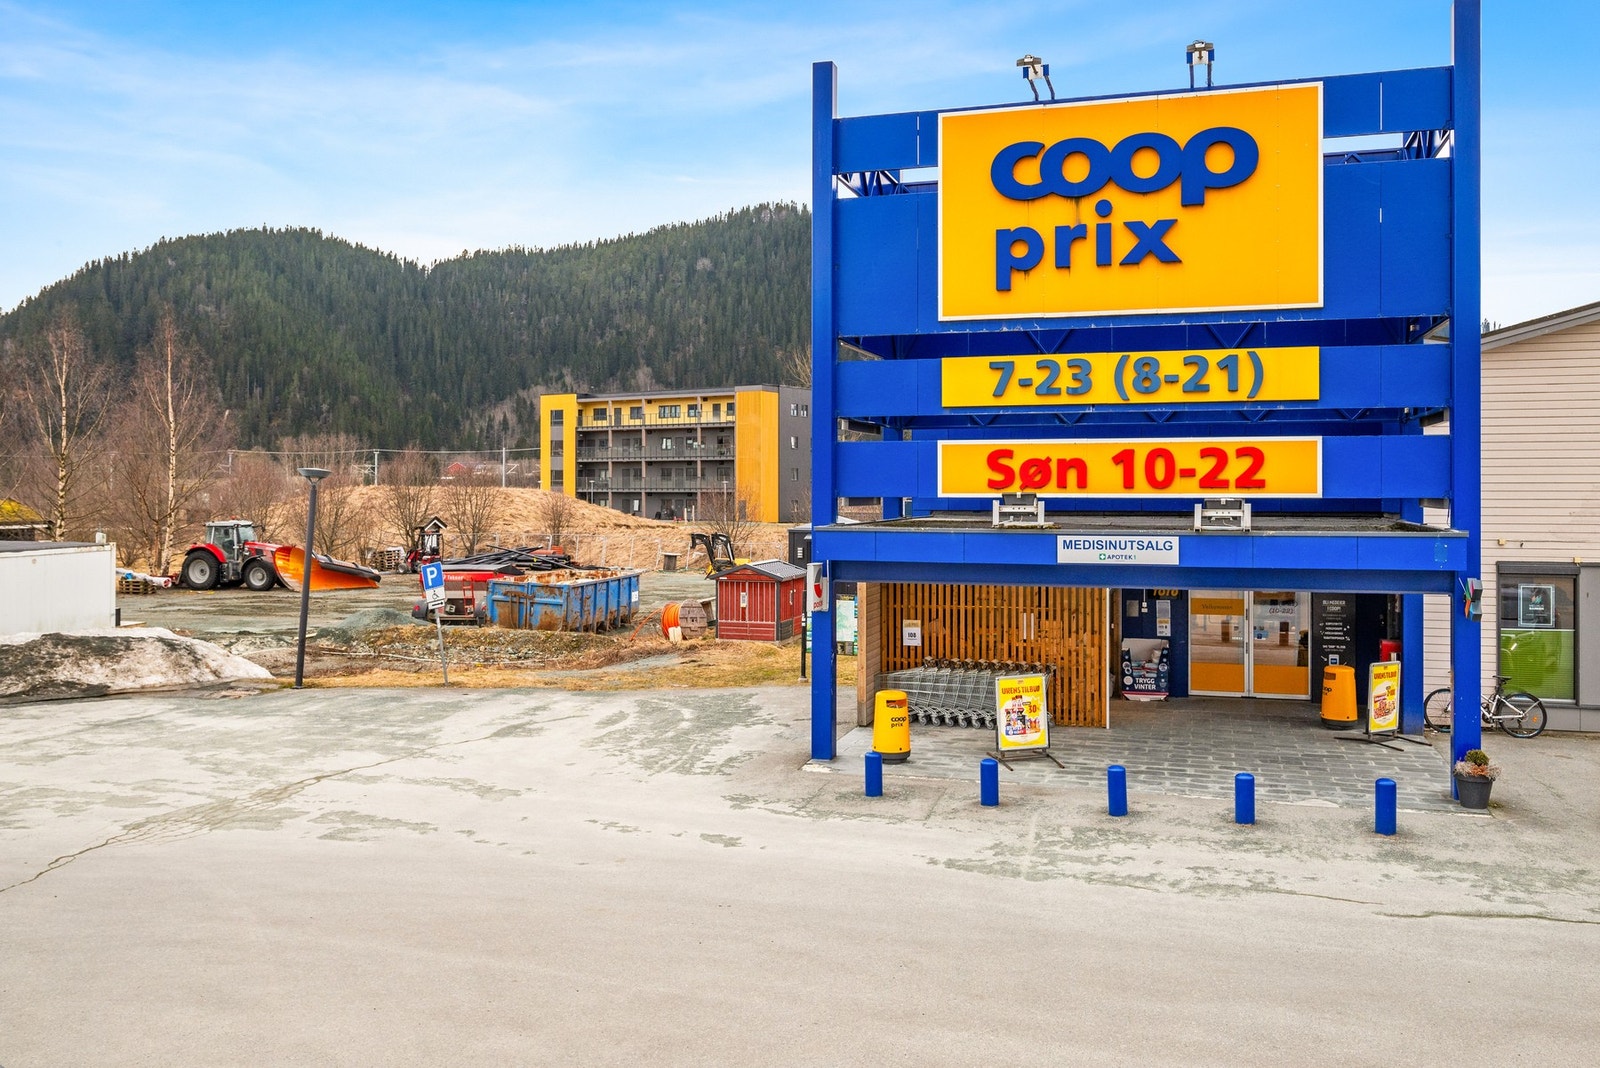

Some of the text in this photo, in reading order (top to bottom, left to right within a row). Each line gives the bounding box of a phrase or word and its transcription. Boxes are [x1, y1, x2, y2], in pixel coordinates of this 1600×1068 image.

[990, 126, 1260, 207] coop
[995, 199, 1182, 291] prix
[989, 351, 1264, 401] 7-23 (8-21)
[986, 446, 1266, 491] Søn 10-22
[1062, 539, 1174, 551] MEDISINUTSALG
[426, 566, 438, 587] P
[1029, 705, 1037, 713] 30
